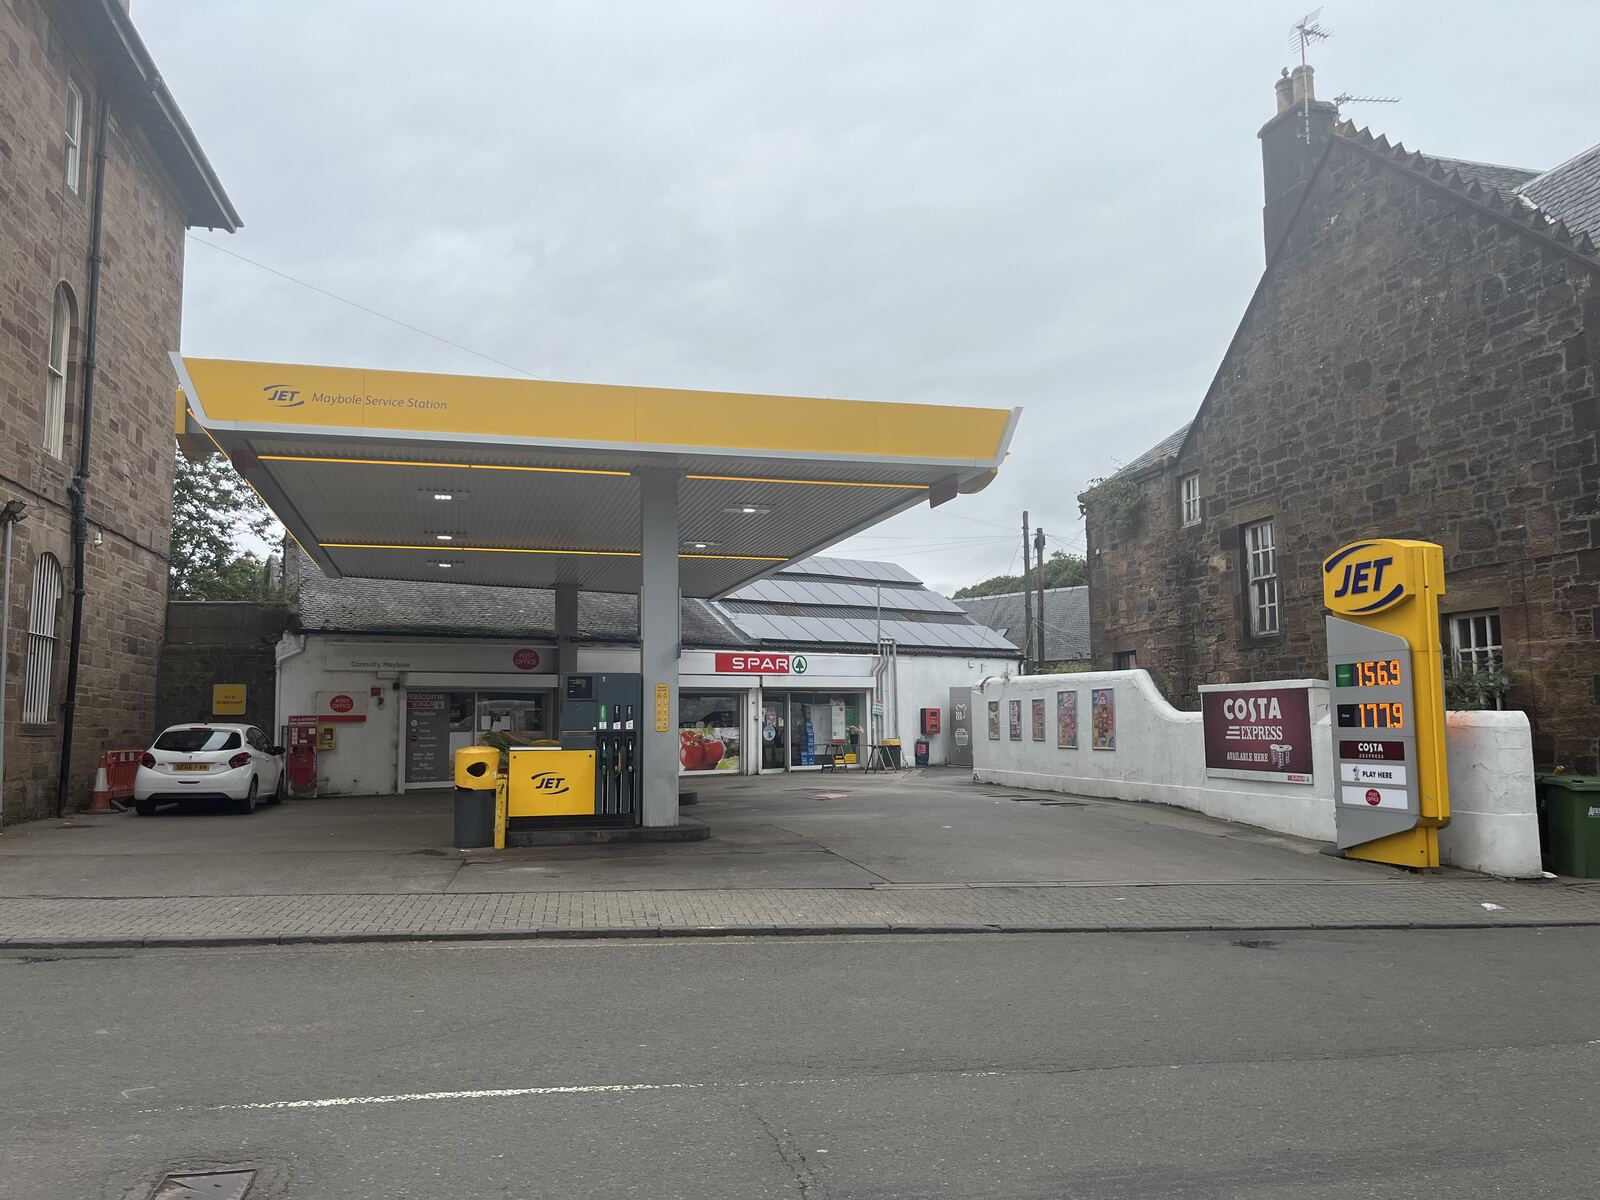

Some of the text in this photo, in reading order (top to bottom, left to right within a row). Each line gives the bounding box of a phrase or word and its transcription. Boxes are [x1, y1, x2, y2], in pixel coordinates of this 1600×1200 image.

[268, 391, 300, 401] JET
[312, 393, 447, 410] Maybole Service Station
[1334, 557, 1392, 597] JET
[382, 661, 410, 669] Maybole
[732, 657, 788, 670] SPAR
[1356, 660, 1400, 687] 156.9
[1223, 697, 1282, 722] COSTA
[1359, 702, 1404, 729] 177.9
[1241, 726, 1283, 740] EXPRESS
[1358, 743, 1383, 752] COSTA
[1227, 752, 1253, 762] AVAILABLE
[1253, 753, 1268, 762] HERE
[1362, 770, 1392, 779] PLAY HERE
[535, 777, 565, 789] JET
